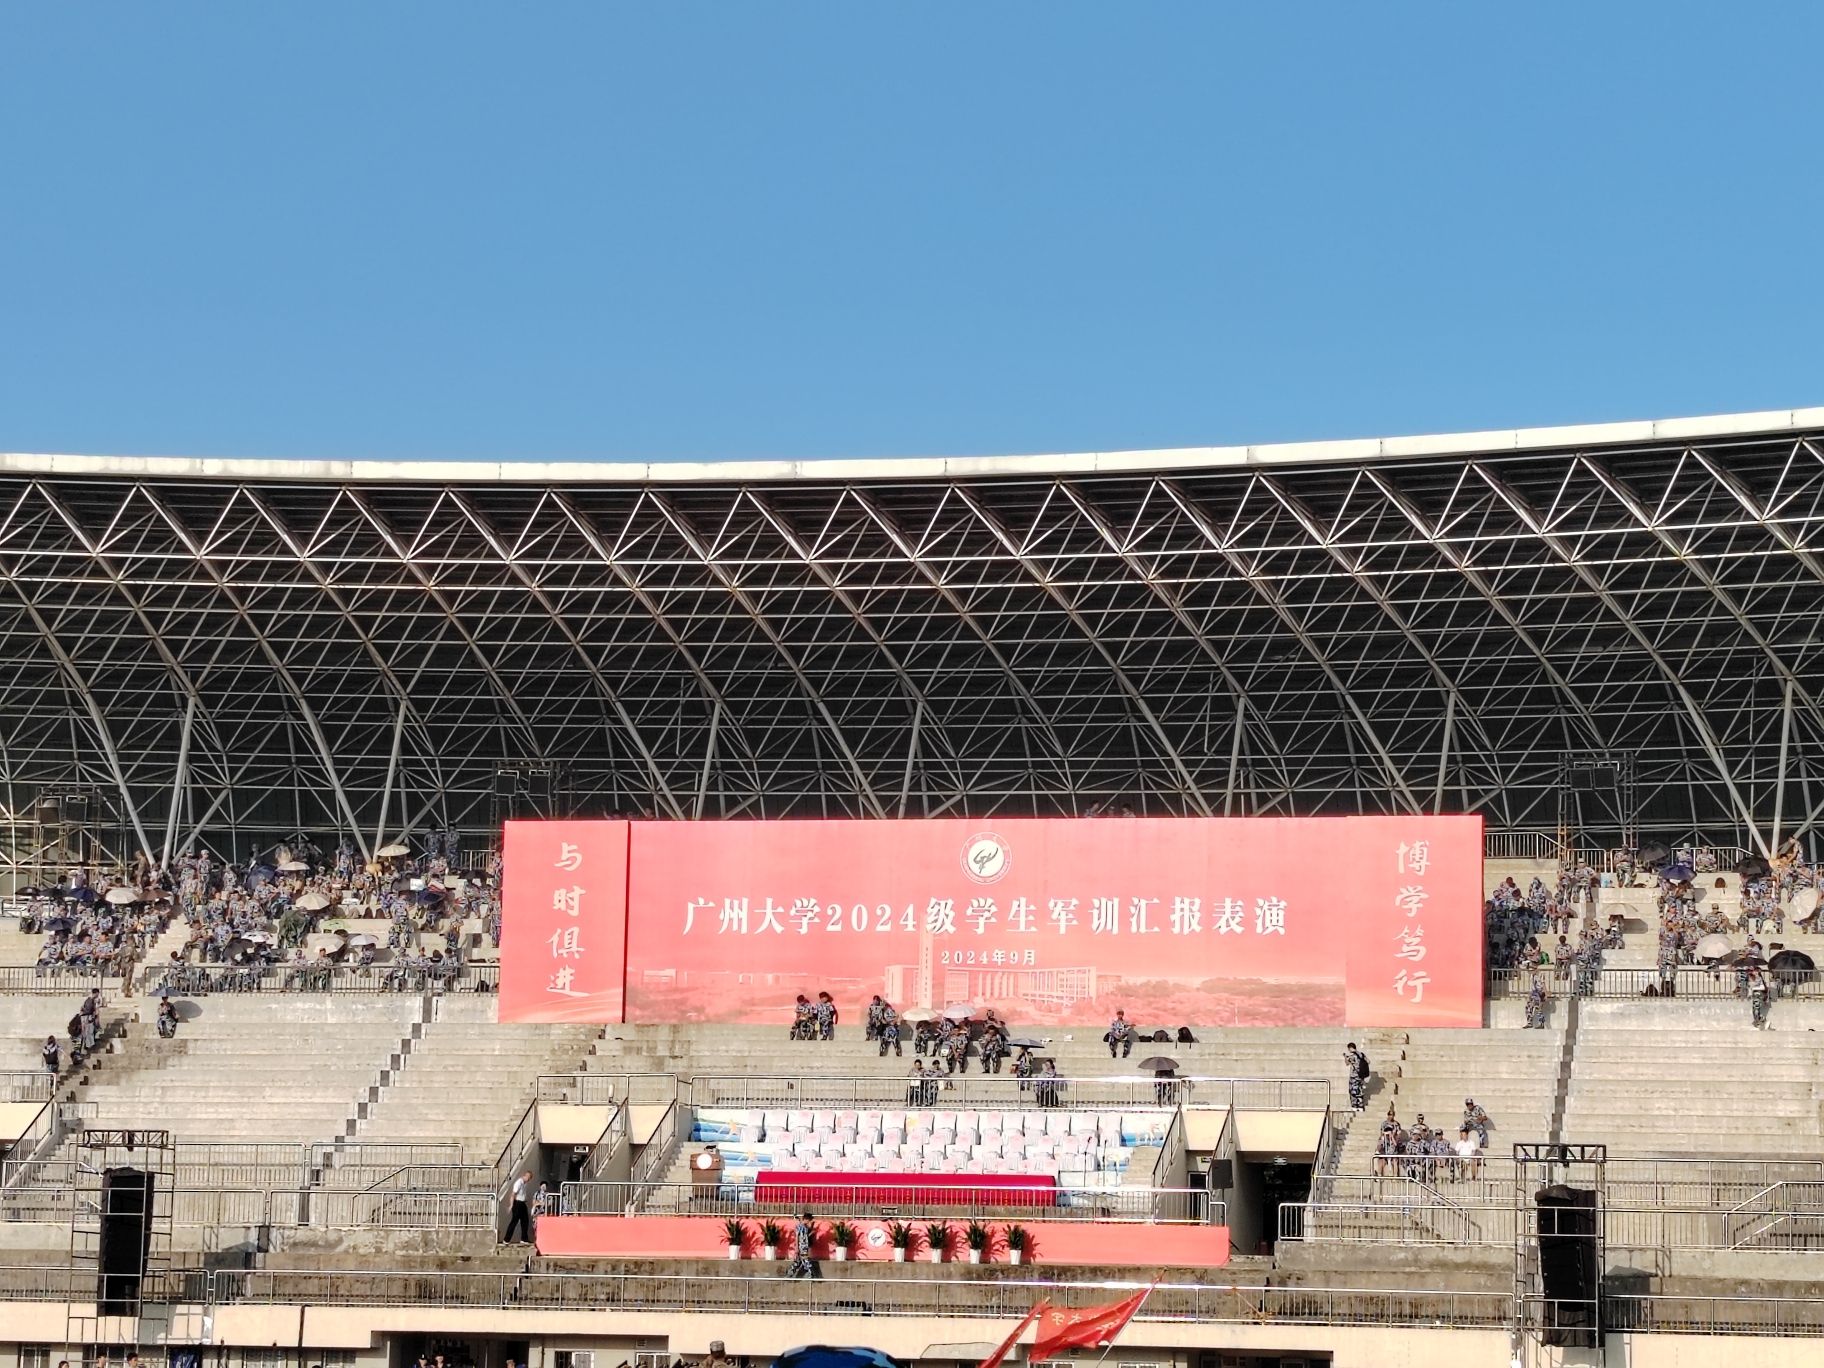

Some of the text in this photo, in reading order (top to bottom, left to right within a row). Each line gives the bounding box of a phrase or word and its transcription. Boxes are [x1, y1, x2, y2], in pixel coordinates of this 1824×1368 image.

[545, 842, 591, 997] 与时俱进
[683, 897, 1288, 935] 广州大学2024级学生军训汇报表演
[941, 949, 1036, 966] 2024年9月
[1393, 840, 1431, 1003] 博学笃行
